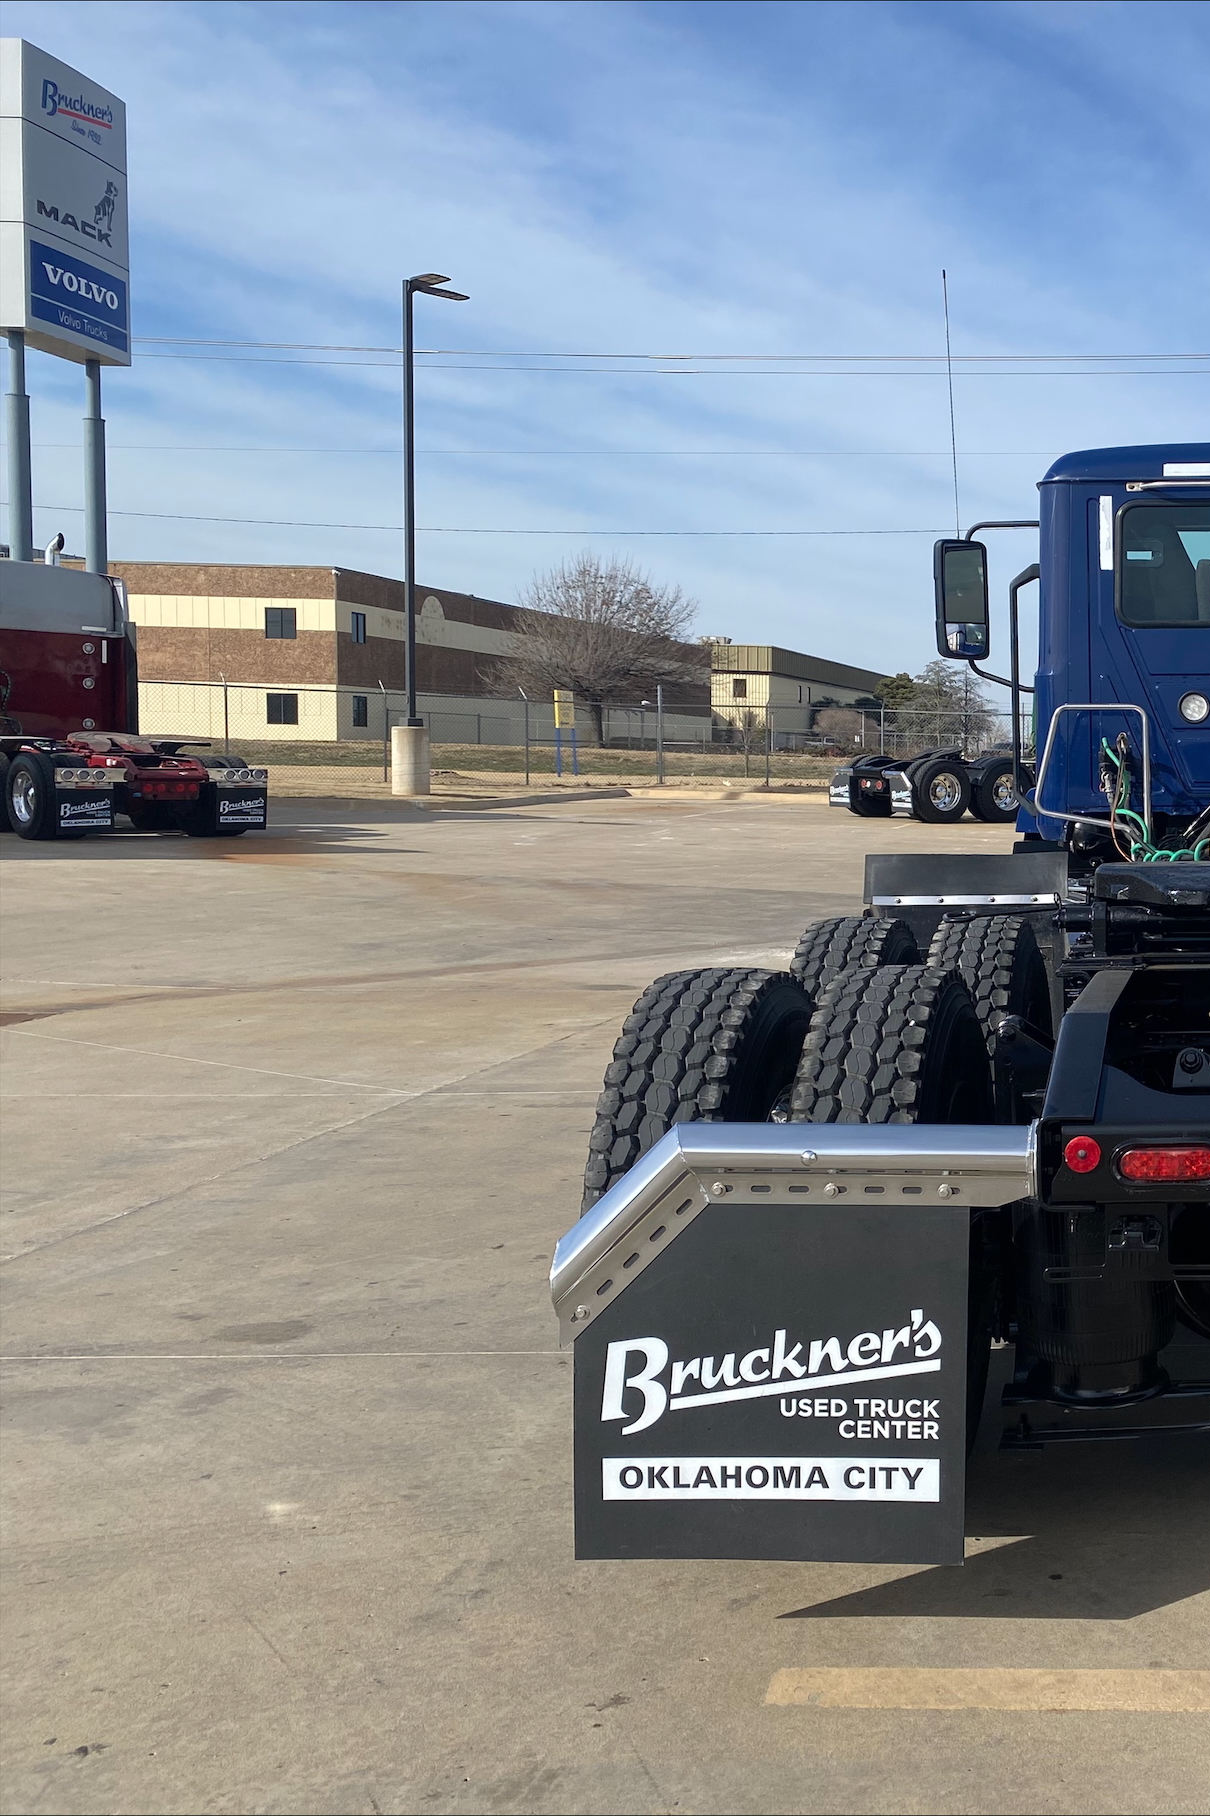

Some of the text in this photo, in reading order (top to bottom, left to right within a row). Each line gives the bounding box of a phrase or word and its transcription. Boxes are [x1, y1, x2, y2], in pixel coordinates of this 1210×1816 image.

[41, 79, 113, 123] Bruckner's
[36, 199, 113, 249] MACK
[42, 262, 119, 310] VOLVO
[58, 309, 108, 341] Volvo Trucks
[600, 1309, 942, 1436] Bruckner's
[780, 1399, 940, 1419] USED TRUCK
[838, 1420, 940, 1440] CENTER
[618, 1465, 924, 1490] OKLAHOMA CITY
